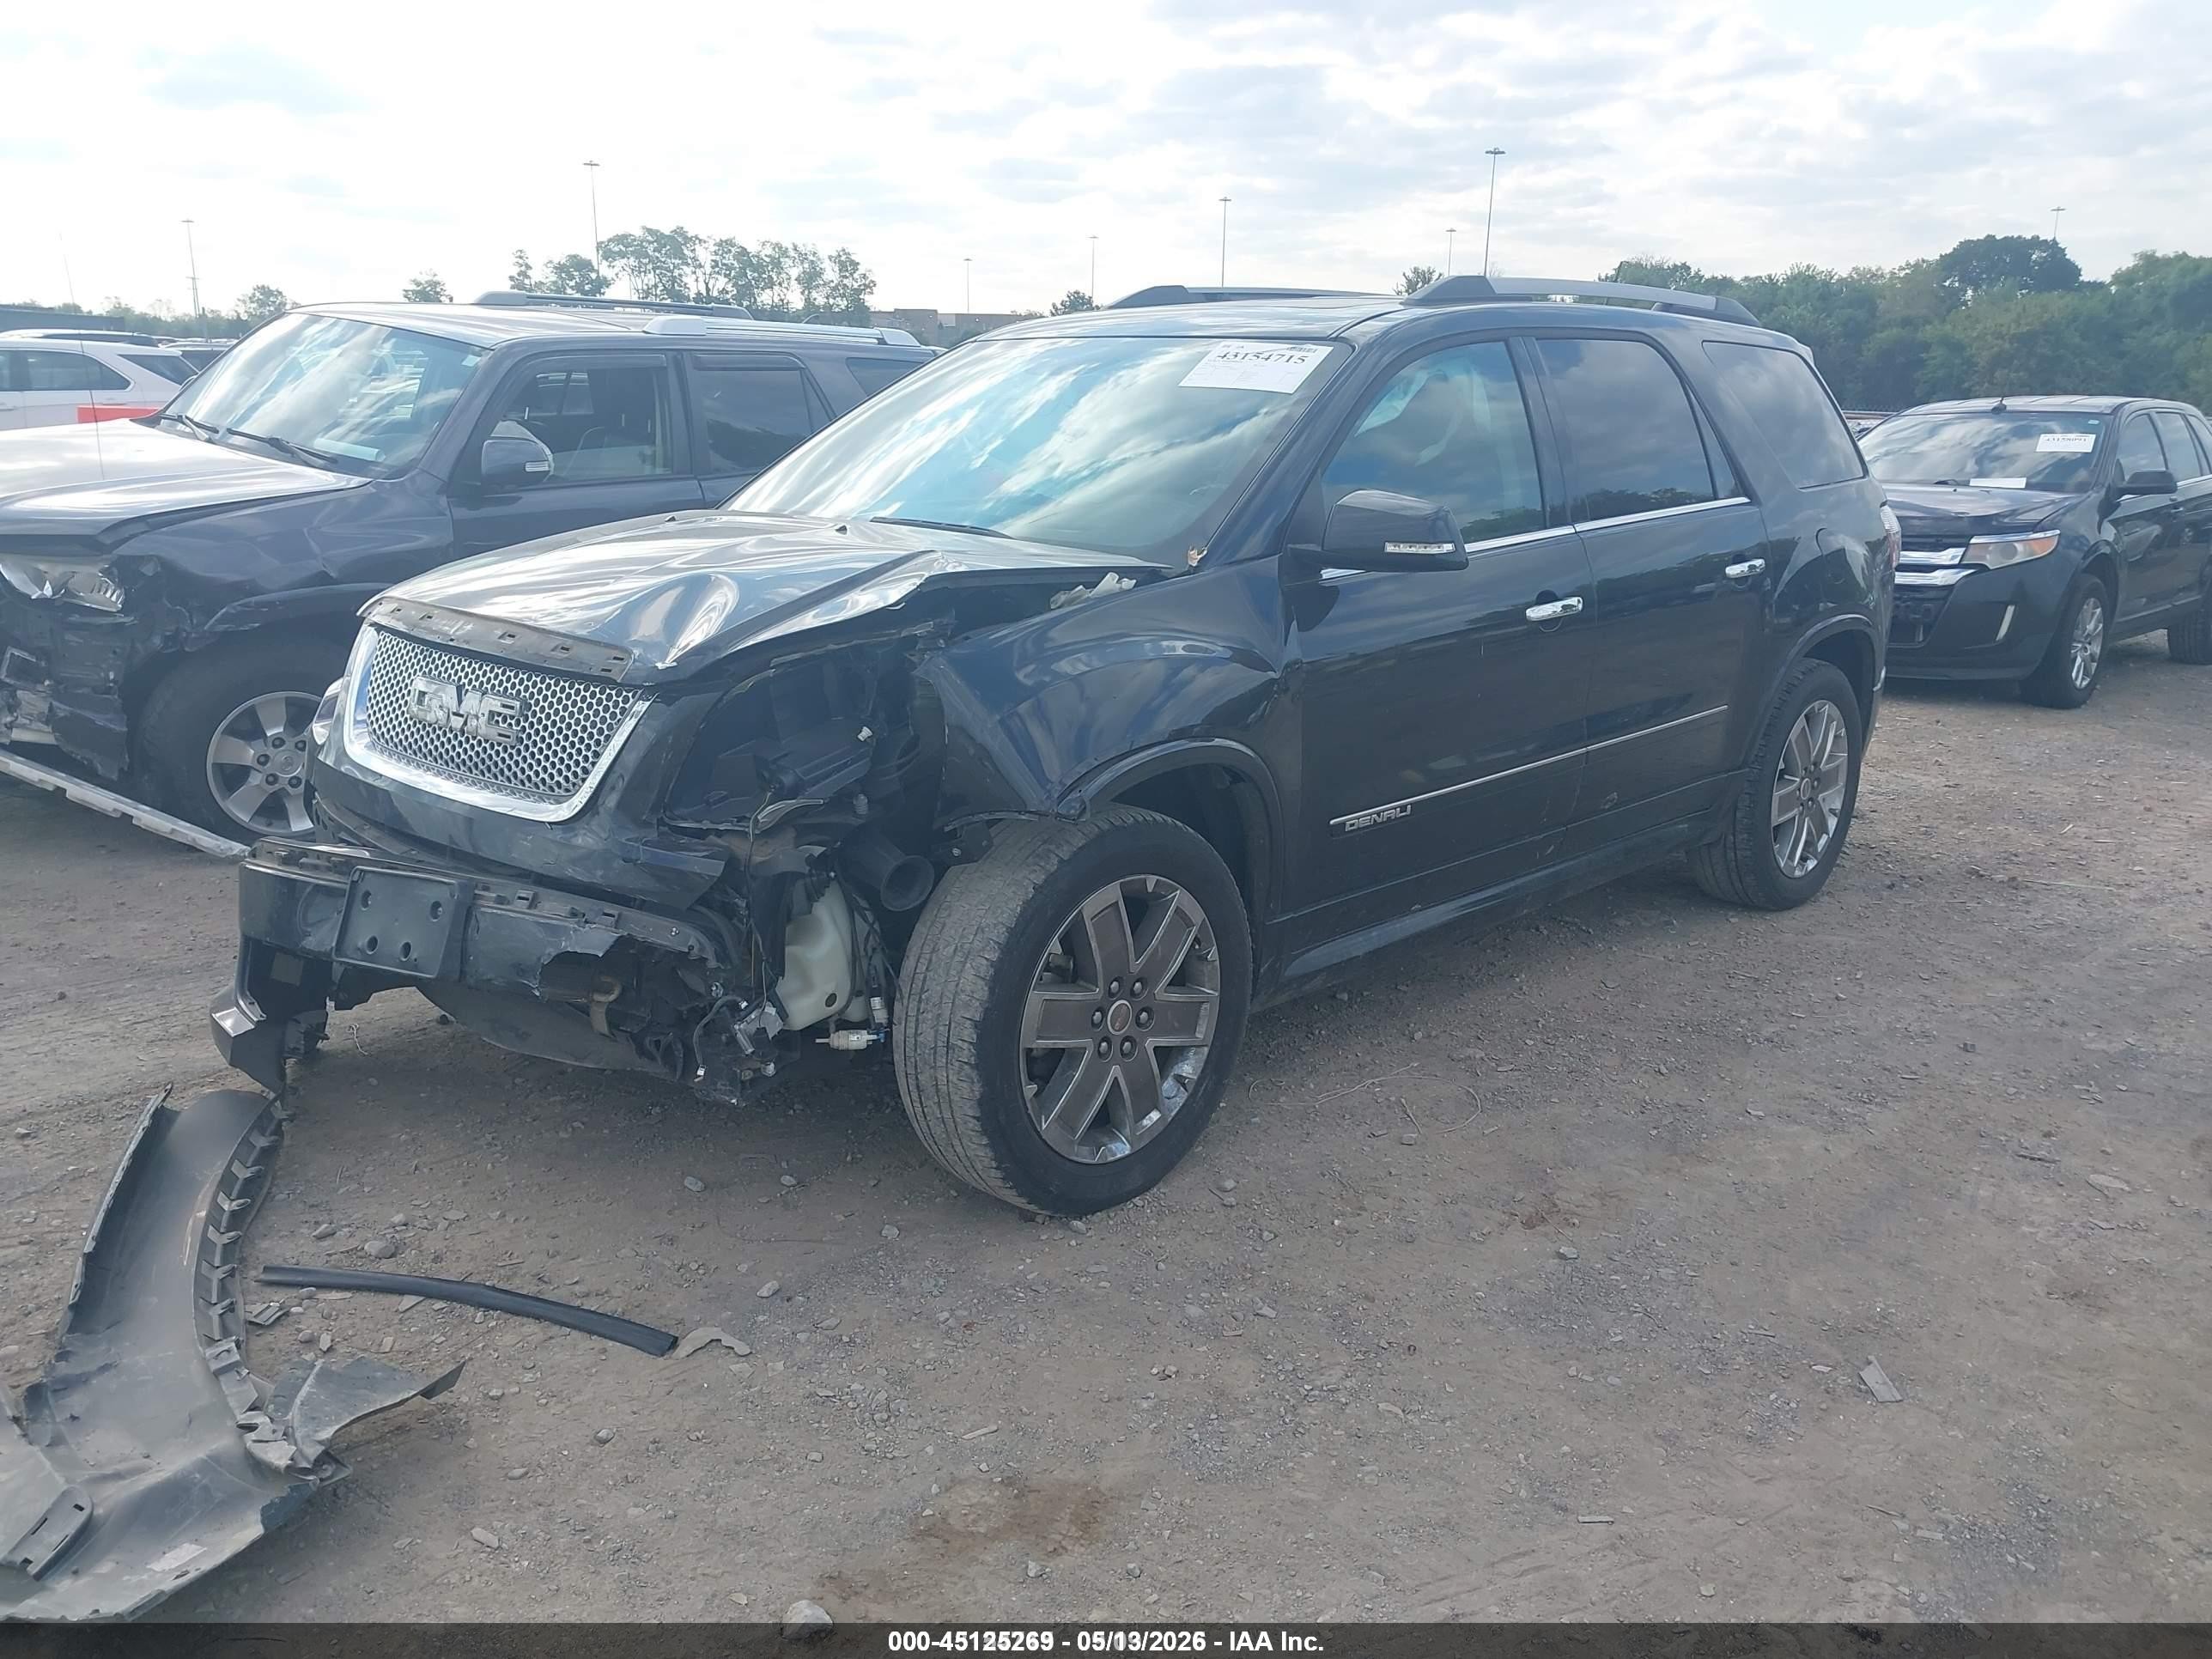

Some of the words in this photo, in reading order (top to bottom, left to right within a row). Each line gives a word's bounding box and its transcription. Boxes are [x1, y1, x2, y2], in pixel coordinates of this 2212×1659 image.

[1217, 350, 1310, 365] 43154715
[408, 674, 526, 746] GMC
[1345, 804, 1412, 832] DENALI
